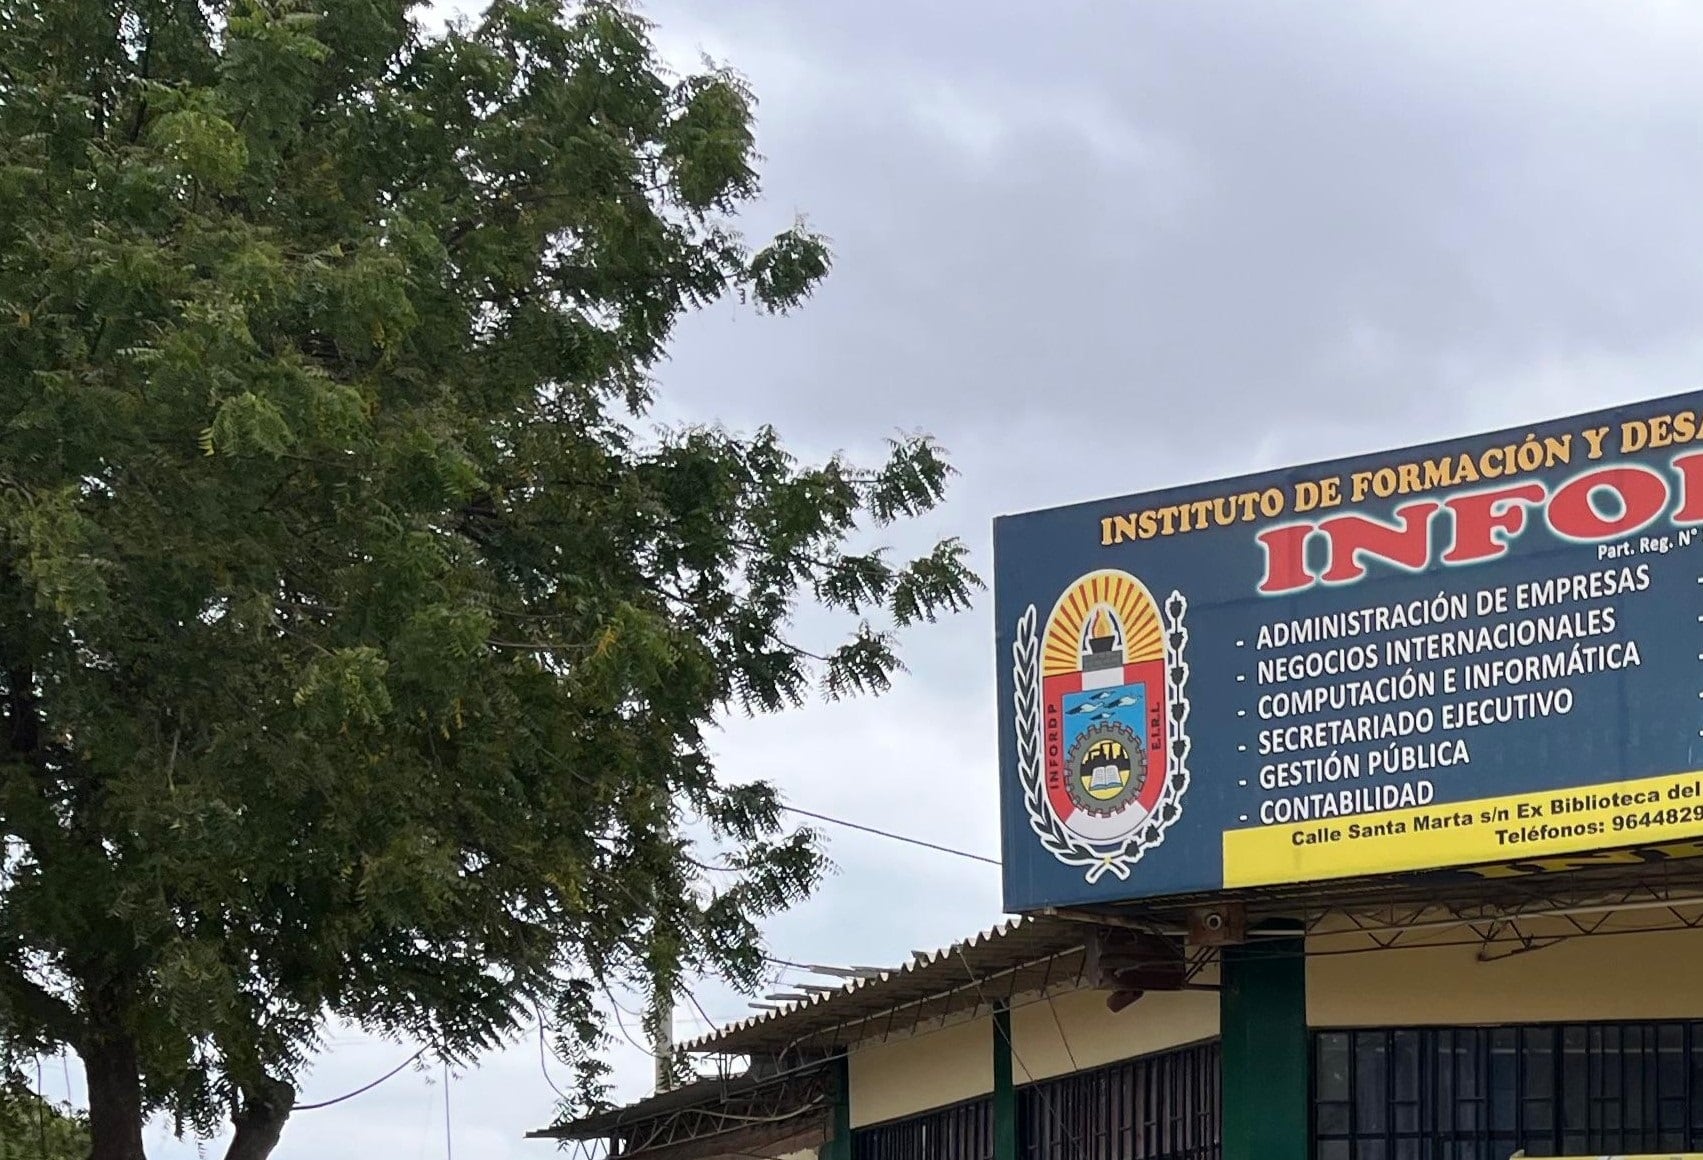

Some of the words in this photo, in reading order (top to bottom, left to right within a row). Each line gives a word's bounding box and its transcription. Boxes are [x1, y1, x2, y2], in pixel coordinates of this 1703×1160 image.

[1101, 487, 1285, 546] INSTITUTO
[1295, 477, 1341, 514] DE
[1351, 433, 1572, 503] FORMACIÓN
[1582, 427, 1610, 460] Y
[1598, 543, 1635, 561] Part.
[1640, 536, 1674, 553] Reg.
[1256, 590, 1469, 651] ADMINISTRACIÓN
[1476, 586, 1510, 615] DE
[1516, 564, 1652, 610] EMPRESAS
[1257, 648, 1378, 686] NEGOCIOS
[1386, 608, 1616, 667] INTERNACIONALES
[1258, 665, 1436, 720] COMPUTACIÓN
[1443, 667, 1457, 694] E
[1465, 640, 1641, 692] INFORMÁTICA
[1048, 704, 1059, 789] INFORDP
[1259, 704, 1434, 755] SECRETARIADO
[1442, 687, 1575, 729] EJECUTIVO
[1259, 750, 1361, 790] GESTIÓN
[1368, 736, 1470, 778] PÚBLICA
[1260, 780, 1435, 826] CONTABILIDAD
[1291, 825, 1343, 847] Calle
[1348, 818, 1407, 840] Santa
[1413, 810, 1474, 833] Marta
[1480, 806, 1510, 824] s/n
[1517, 803, 1544, 819] Ex
[1550, 789, 1661, 816] Biblioteca
[1667, 781, 1701, 800] del
[1495, 819, 1605, 846] Teléfonos:
